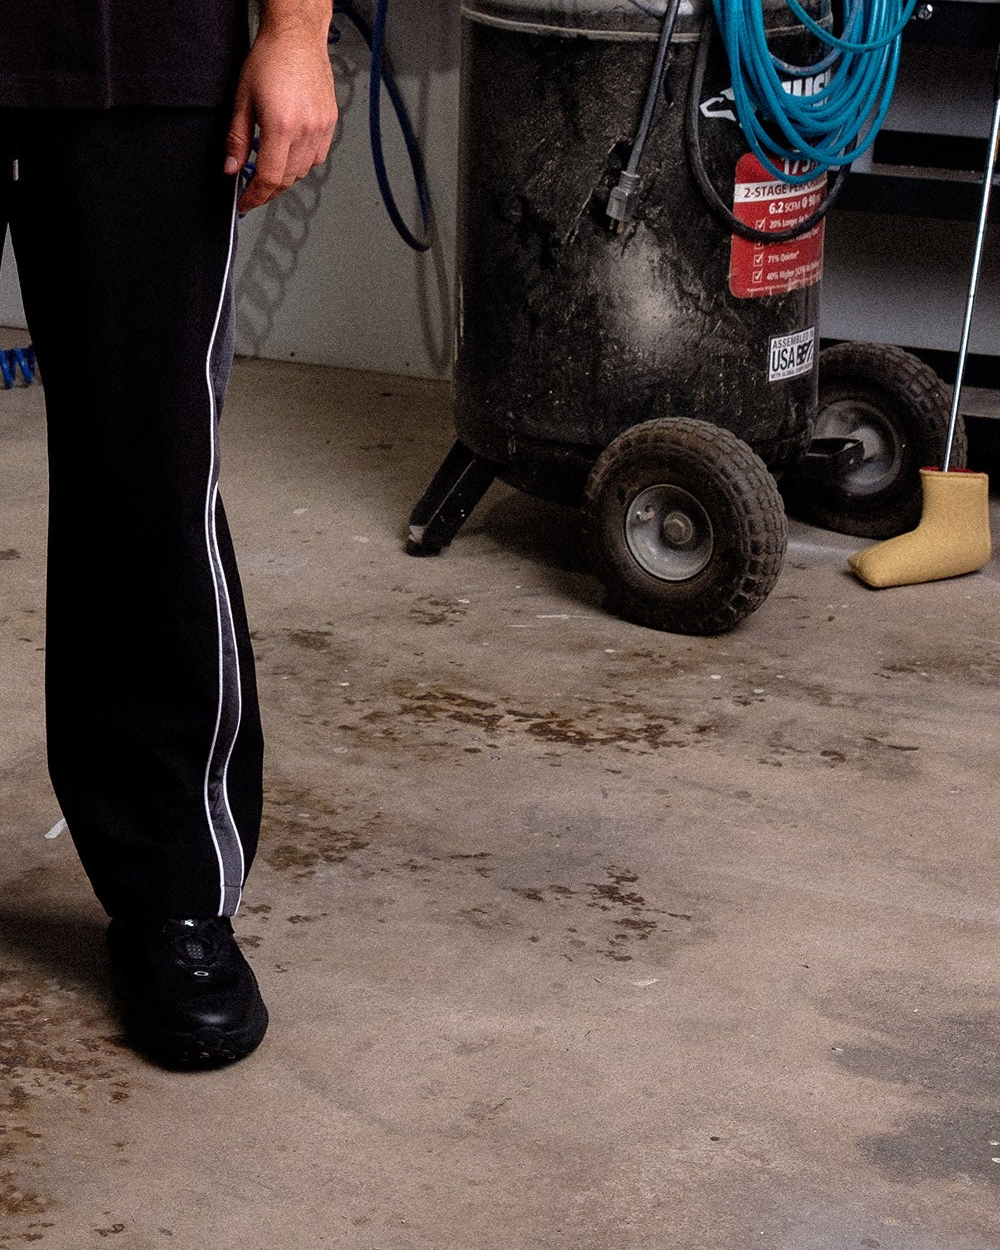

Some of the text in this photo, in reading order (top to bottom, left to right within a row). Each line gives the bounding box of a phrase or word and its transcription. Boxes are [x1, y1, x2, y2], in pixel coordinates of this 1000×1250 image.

[744, 184, 787, 199] 2-STAGE
[768, 202, 784, 215] 6.2
[772, 347, 795, 372] USA
